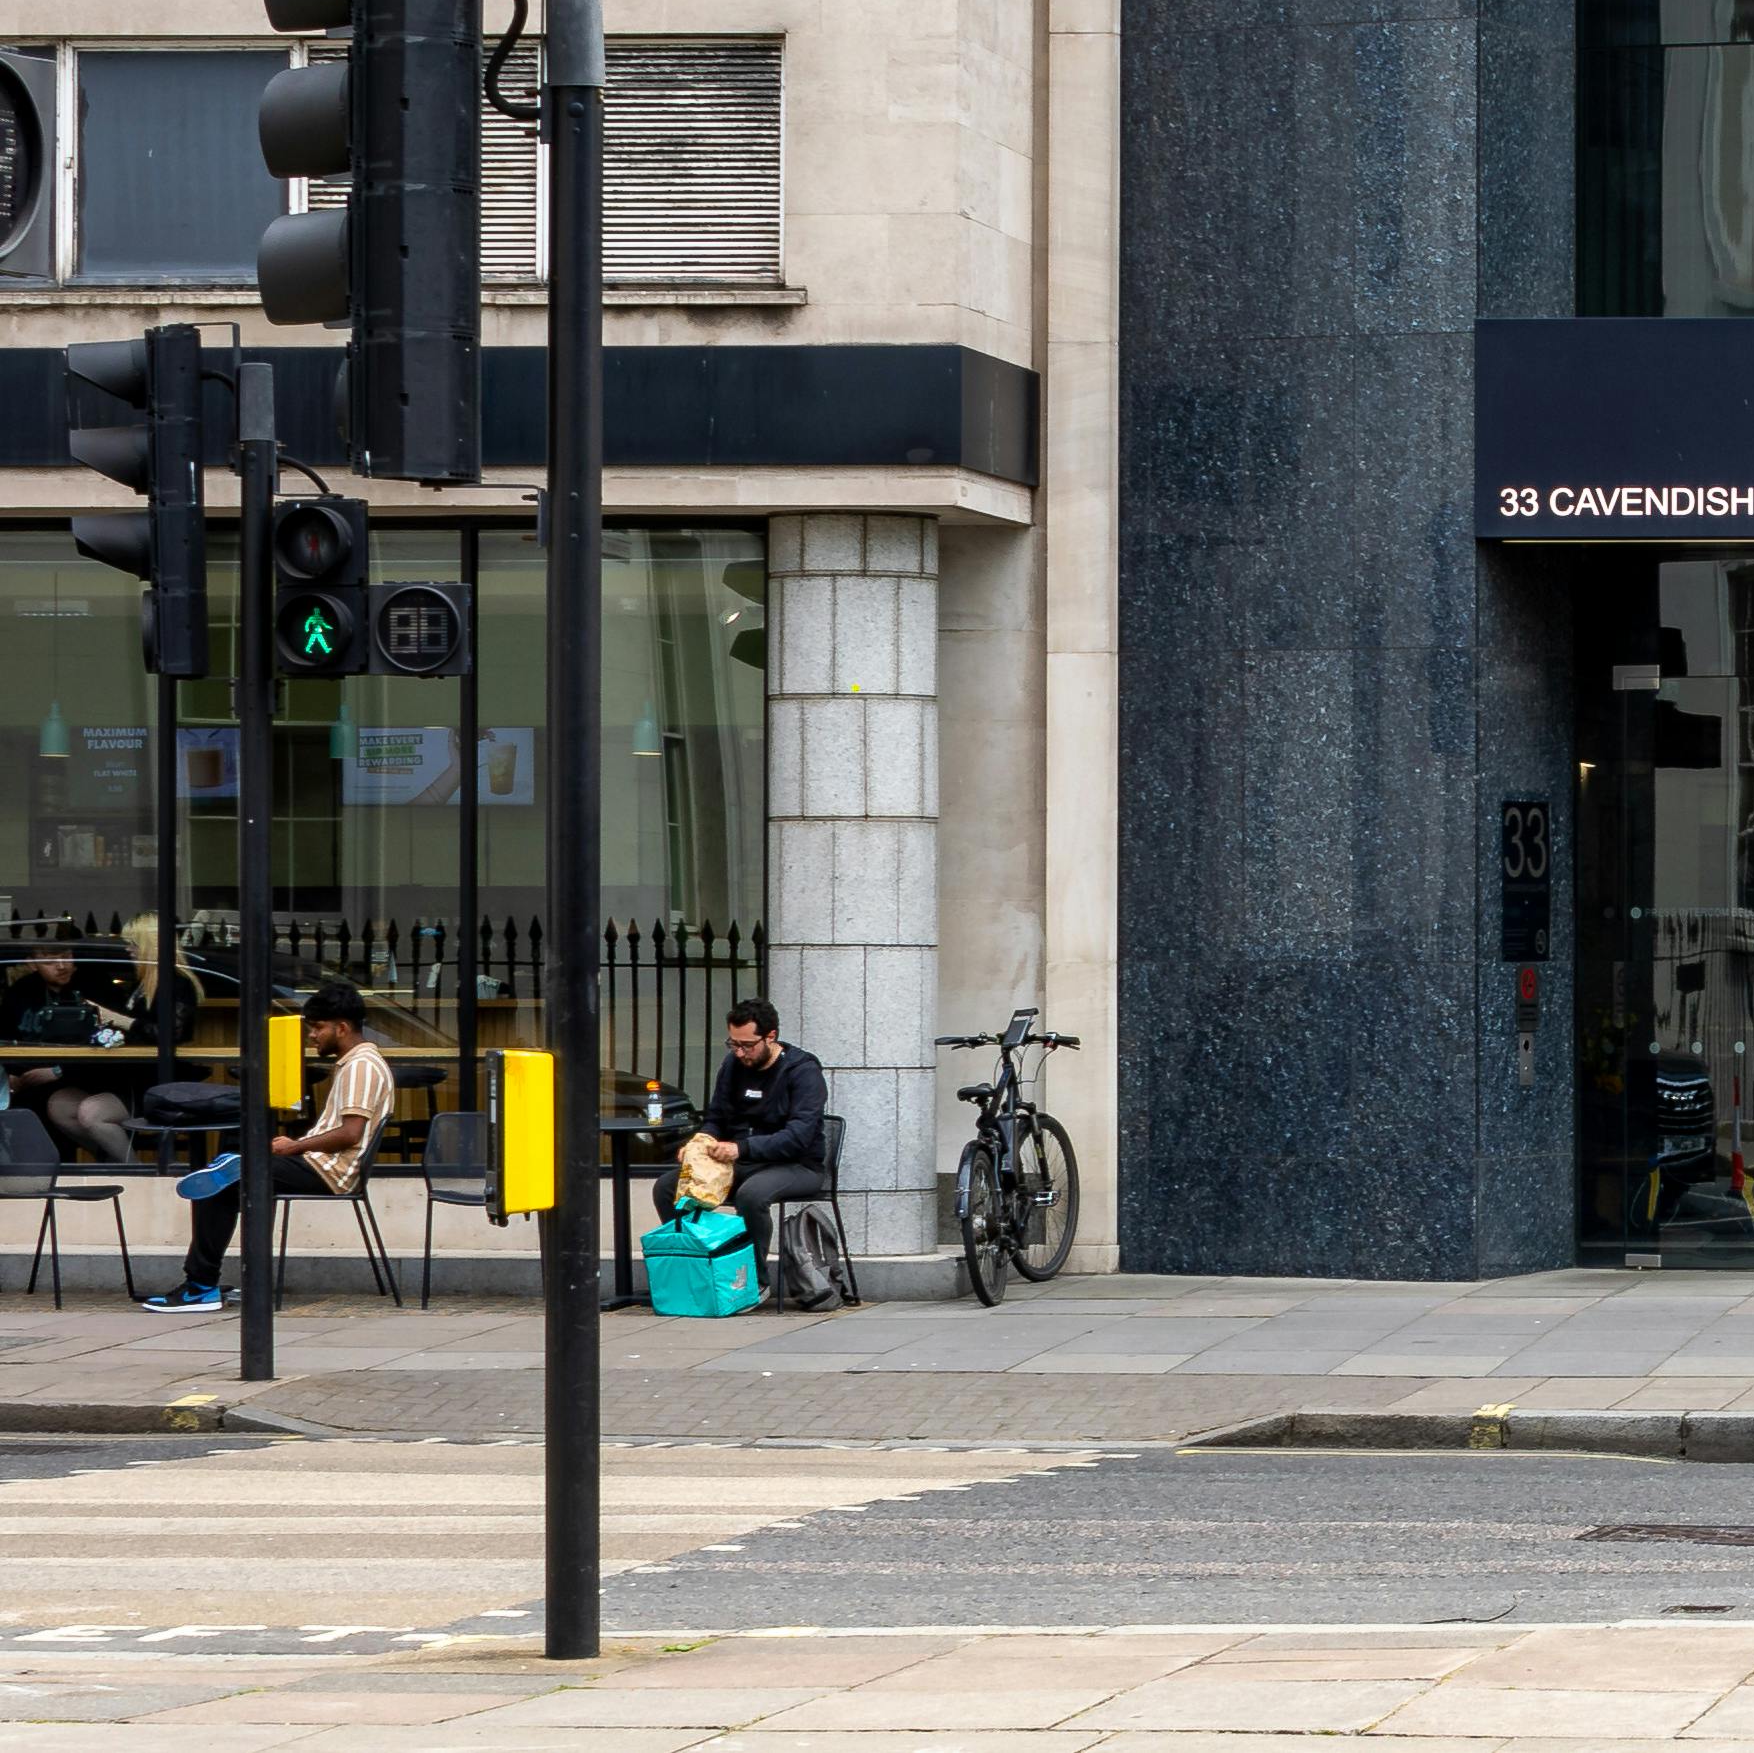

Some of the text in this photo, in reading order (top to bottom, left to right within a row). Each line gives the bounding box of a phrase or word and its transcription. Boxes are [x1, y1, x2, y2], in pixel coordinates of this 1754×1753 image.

[1500, 487, 1539, 517] 33
[1549, 487, 1754, 517] CAVENDISH
[83, 727, 147, 736] MAXIMUM
[87, 739, 143, 749] FLAVOUR
[359, 756, 420, 766] REWARDING
[1504, 807, 1547, 878] 33
